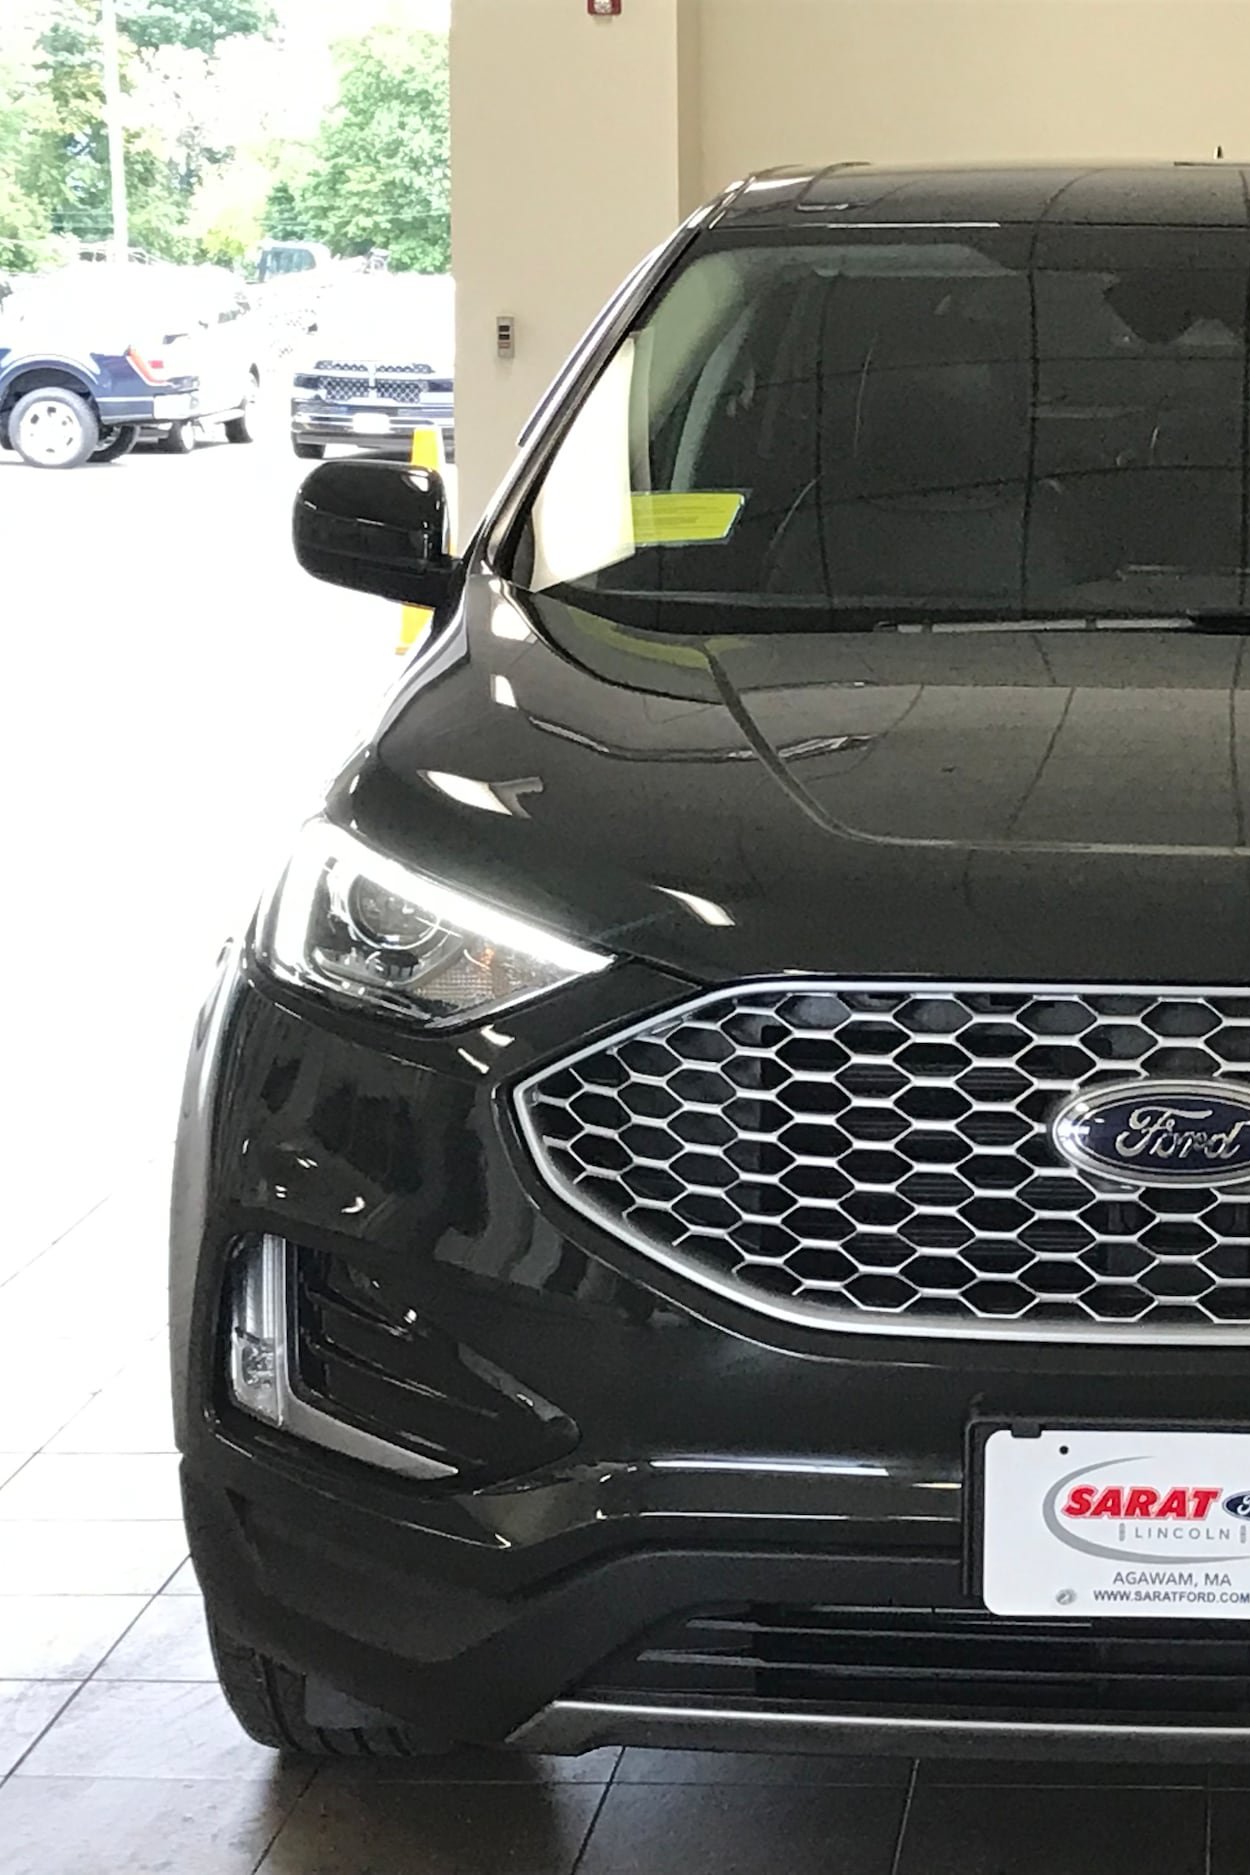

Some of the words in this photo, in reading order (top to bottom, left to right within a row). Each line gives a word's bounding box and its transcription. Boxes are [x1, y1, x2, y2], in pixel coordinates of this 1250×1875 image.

[1061, 1485, 1223, 1520] SARAT
[1134, 1526, 1231, 1541] LINCOLN
[1112, 1571, 1199, 1588] AGAWAM,
[1204, 1572, 1232, 1587] MA
[1093, 1589, 1250, 1604] WWW.SARATFORD.COM
